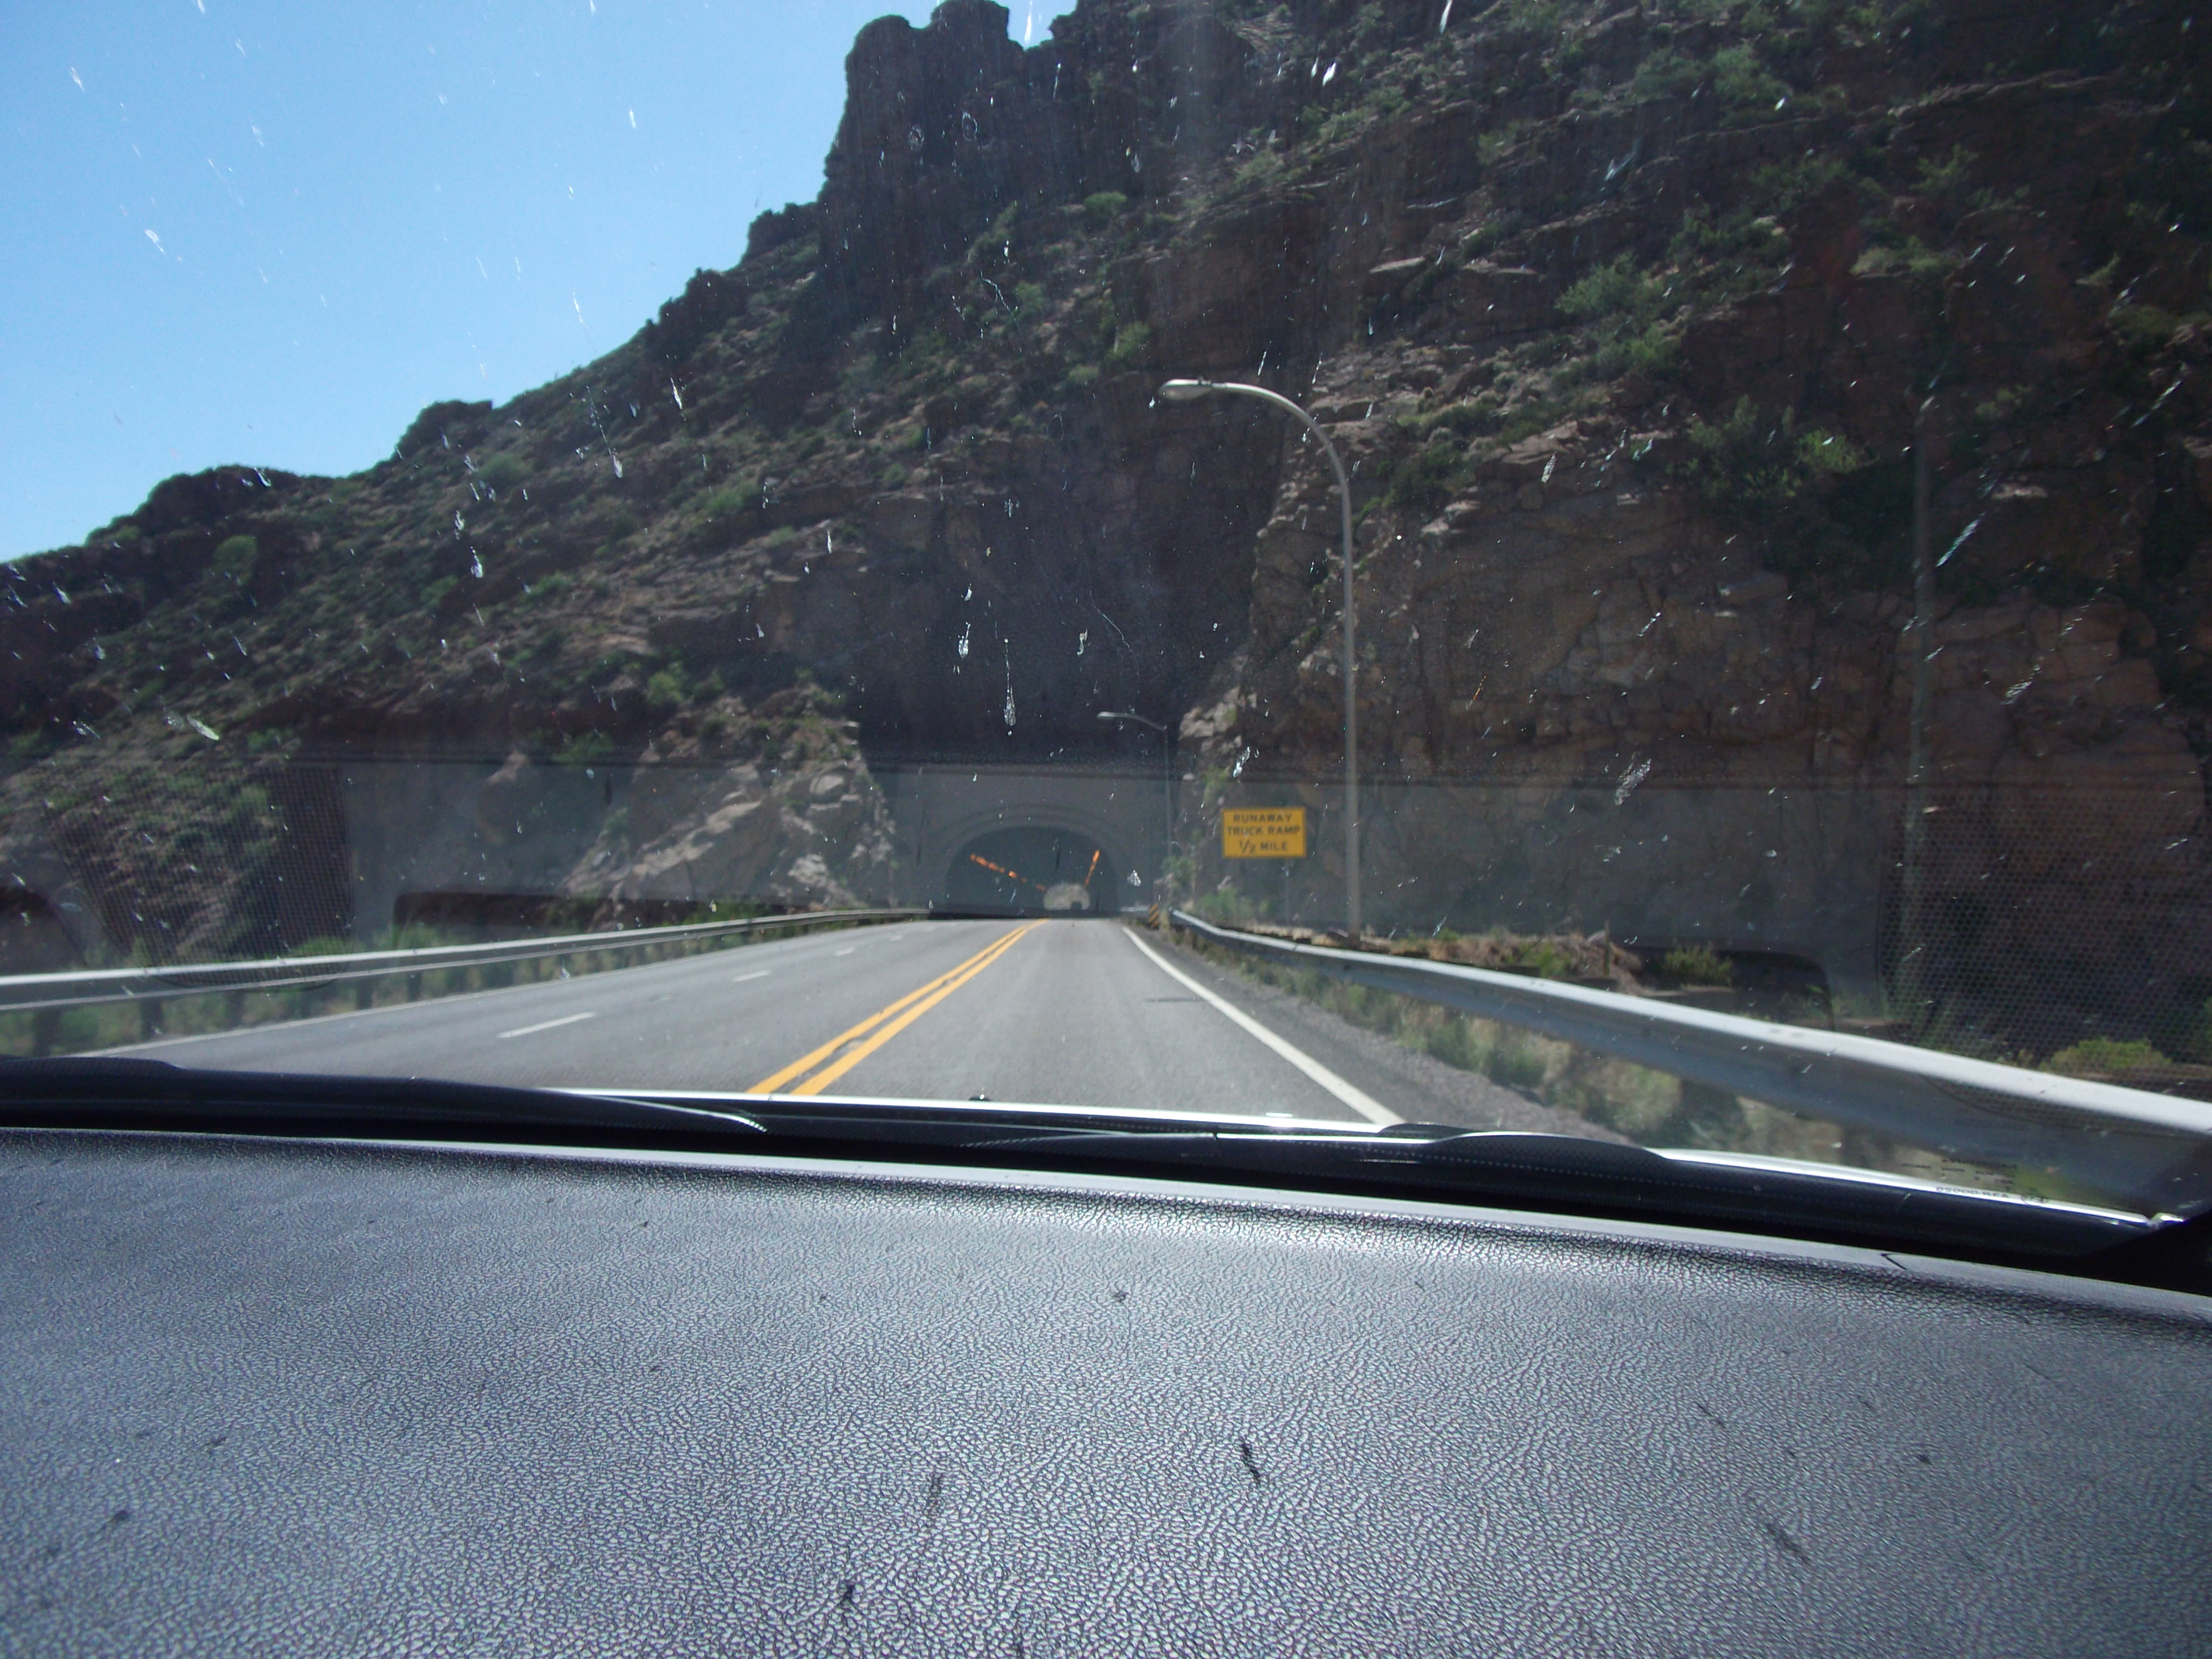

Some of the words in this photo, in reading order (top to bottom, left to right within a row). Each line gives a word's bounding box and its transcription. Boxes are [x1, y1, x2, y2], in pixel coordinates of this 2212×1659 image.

[1234, 814, 1292, 822] RUNAWAY
[1227, 826, 1262, 836] TRUCK
[1267, 826, 1300, 836] RAMP
[1260, 841, 1288, 851] MILE
